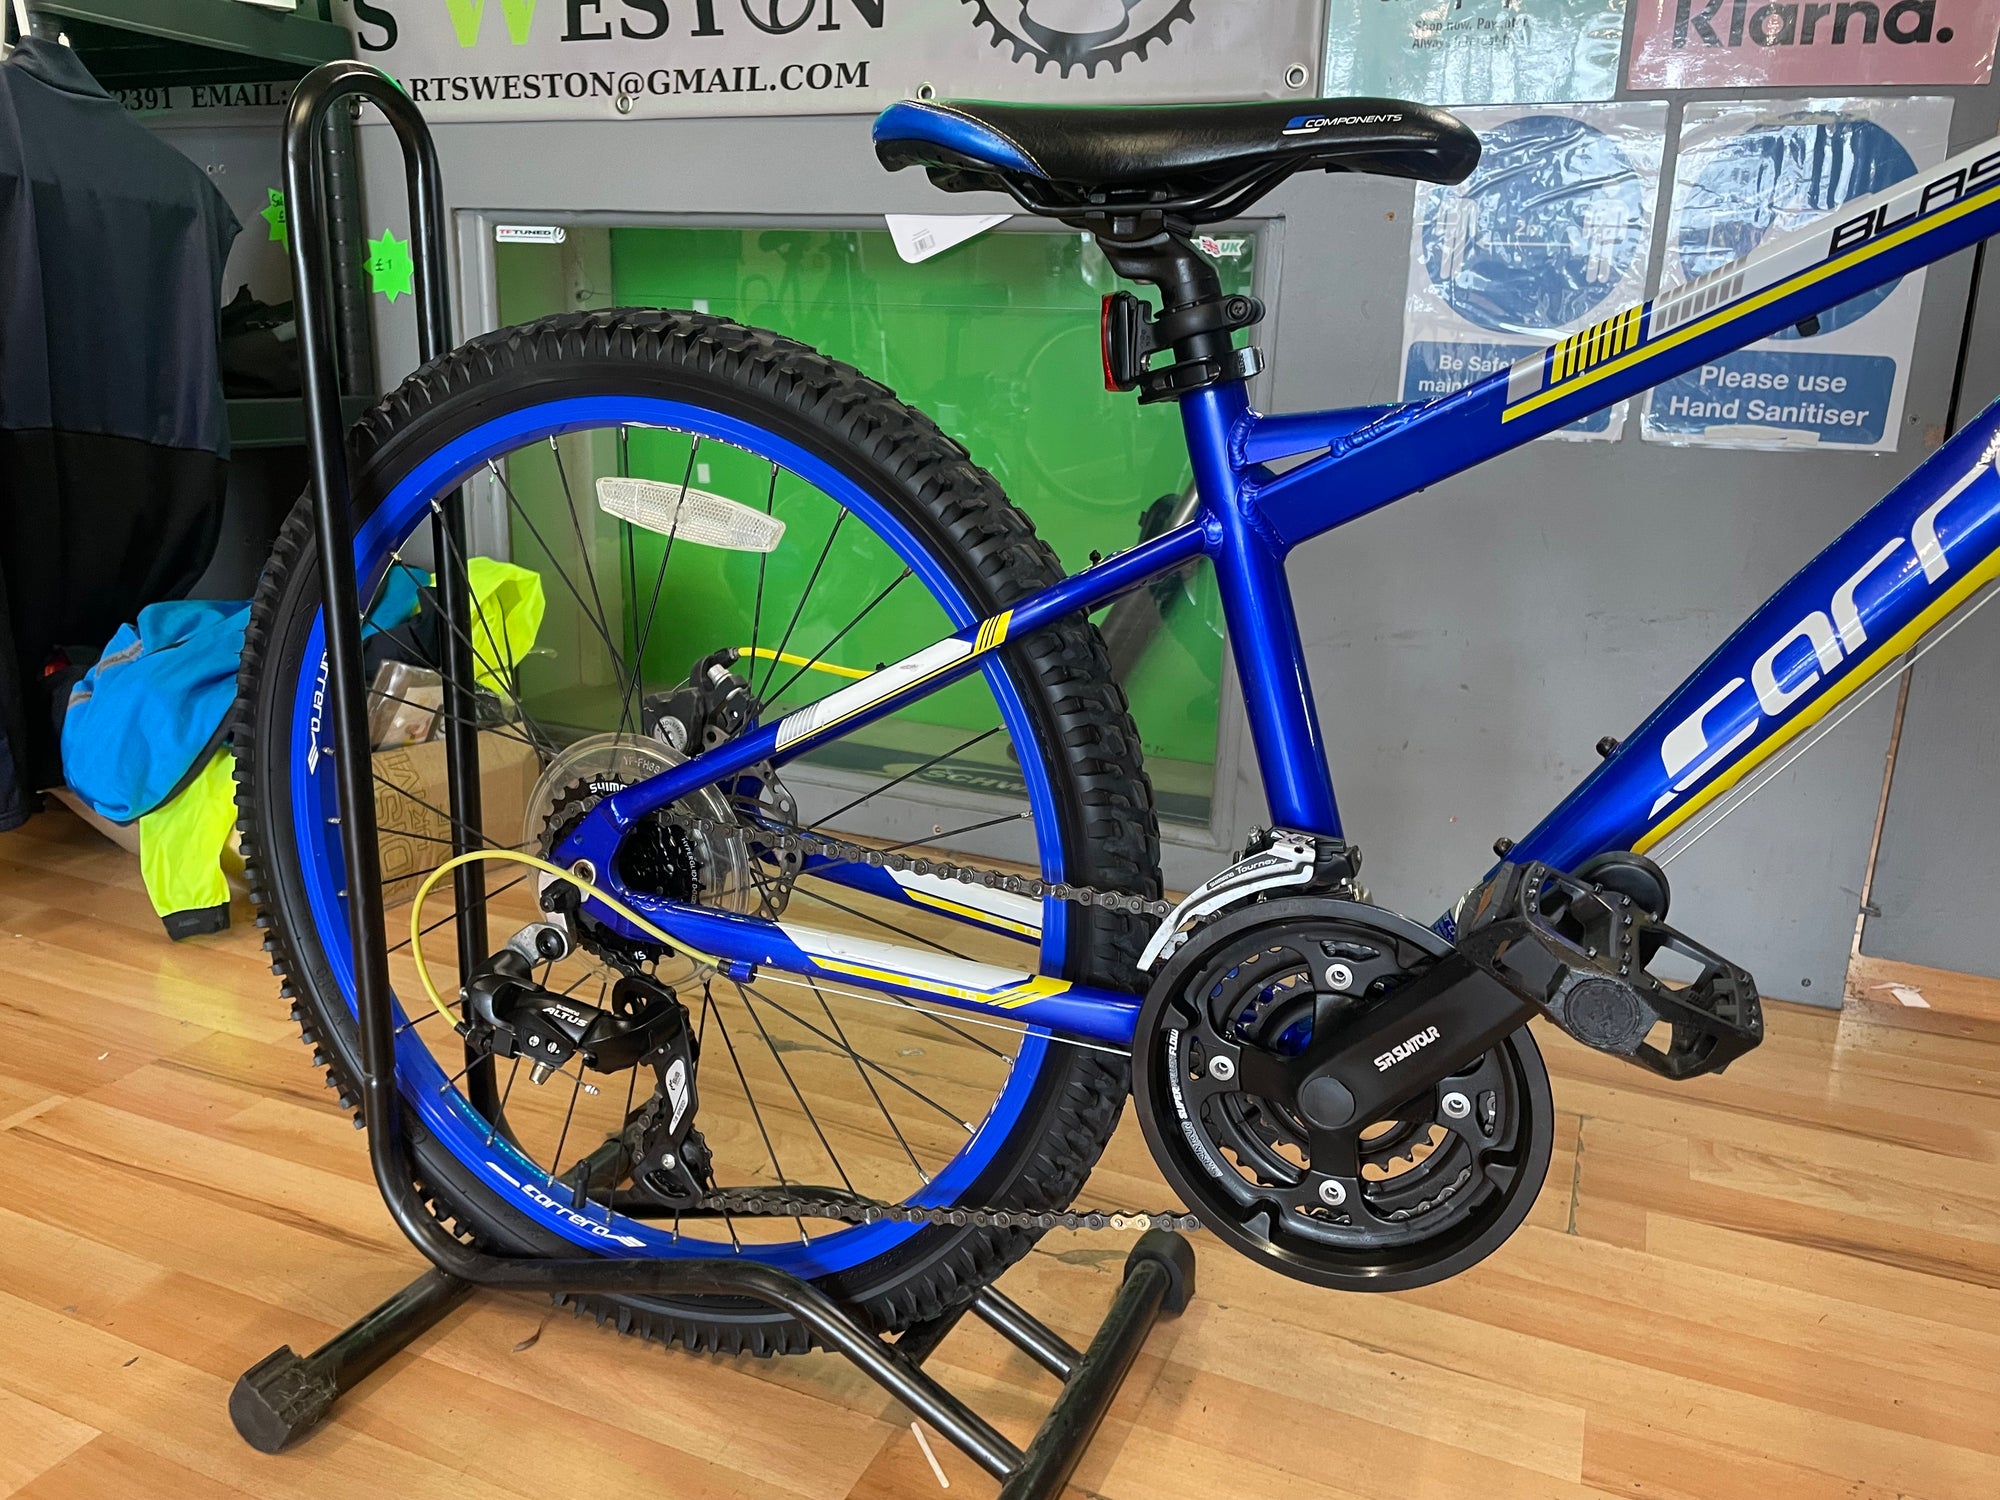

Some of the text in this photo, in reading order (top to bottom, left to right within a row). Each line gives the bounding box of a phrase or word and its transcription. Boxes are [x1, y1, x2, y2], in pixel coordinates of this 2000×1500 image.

[1415, 20, 1443, 32] Shop
[1477, 17, 1497, 31] Pay
[190, 83, 288, 109] EMAIL:
[1305, 114, 1403, 128] COMPONENTS
[1220, 242, 1240, 253] UK
[1439, 354, 1464, 371] Be
[1700, 365, 1848, 393] Please use
[1668, 394, 1870, 427] Hand Sanitiser
[1648, 448, 2000, 821] carr
[1235, 858, 1278, 874] Tourney
[633, 950, 647, 960] 15
[542, 1007, 588, 1027] ALTUS
[1391, 1026, 1441, 1062] SUNTOUR
